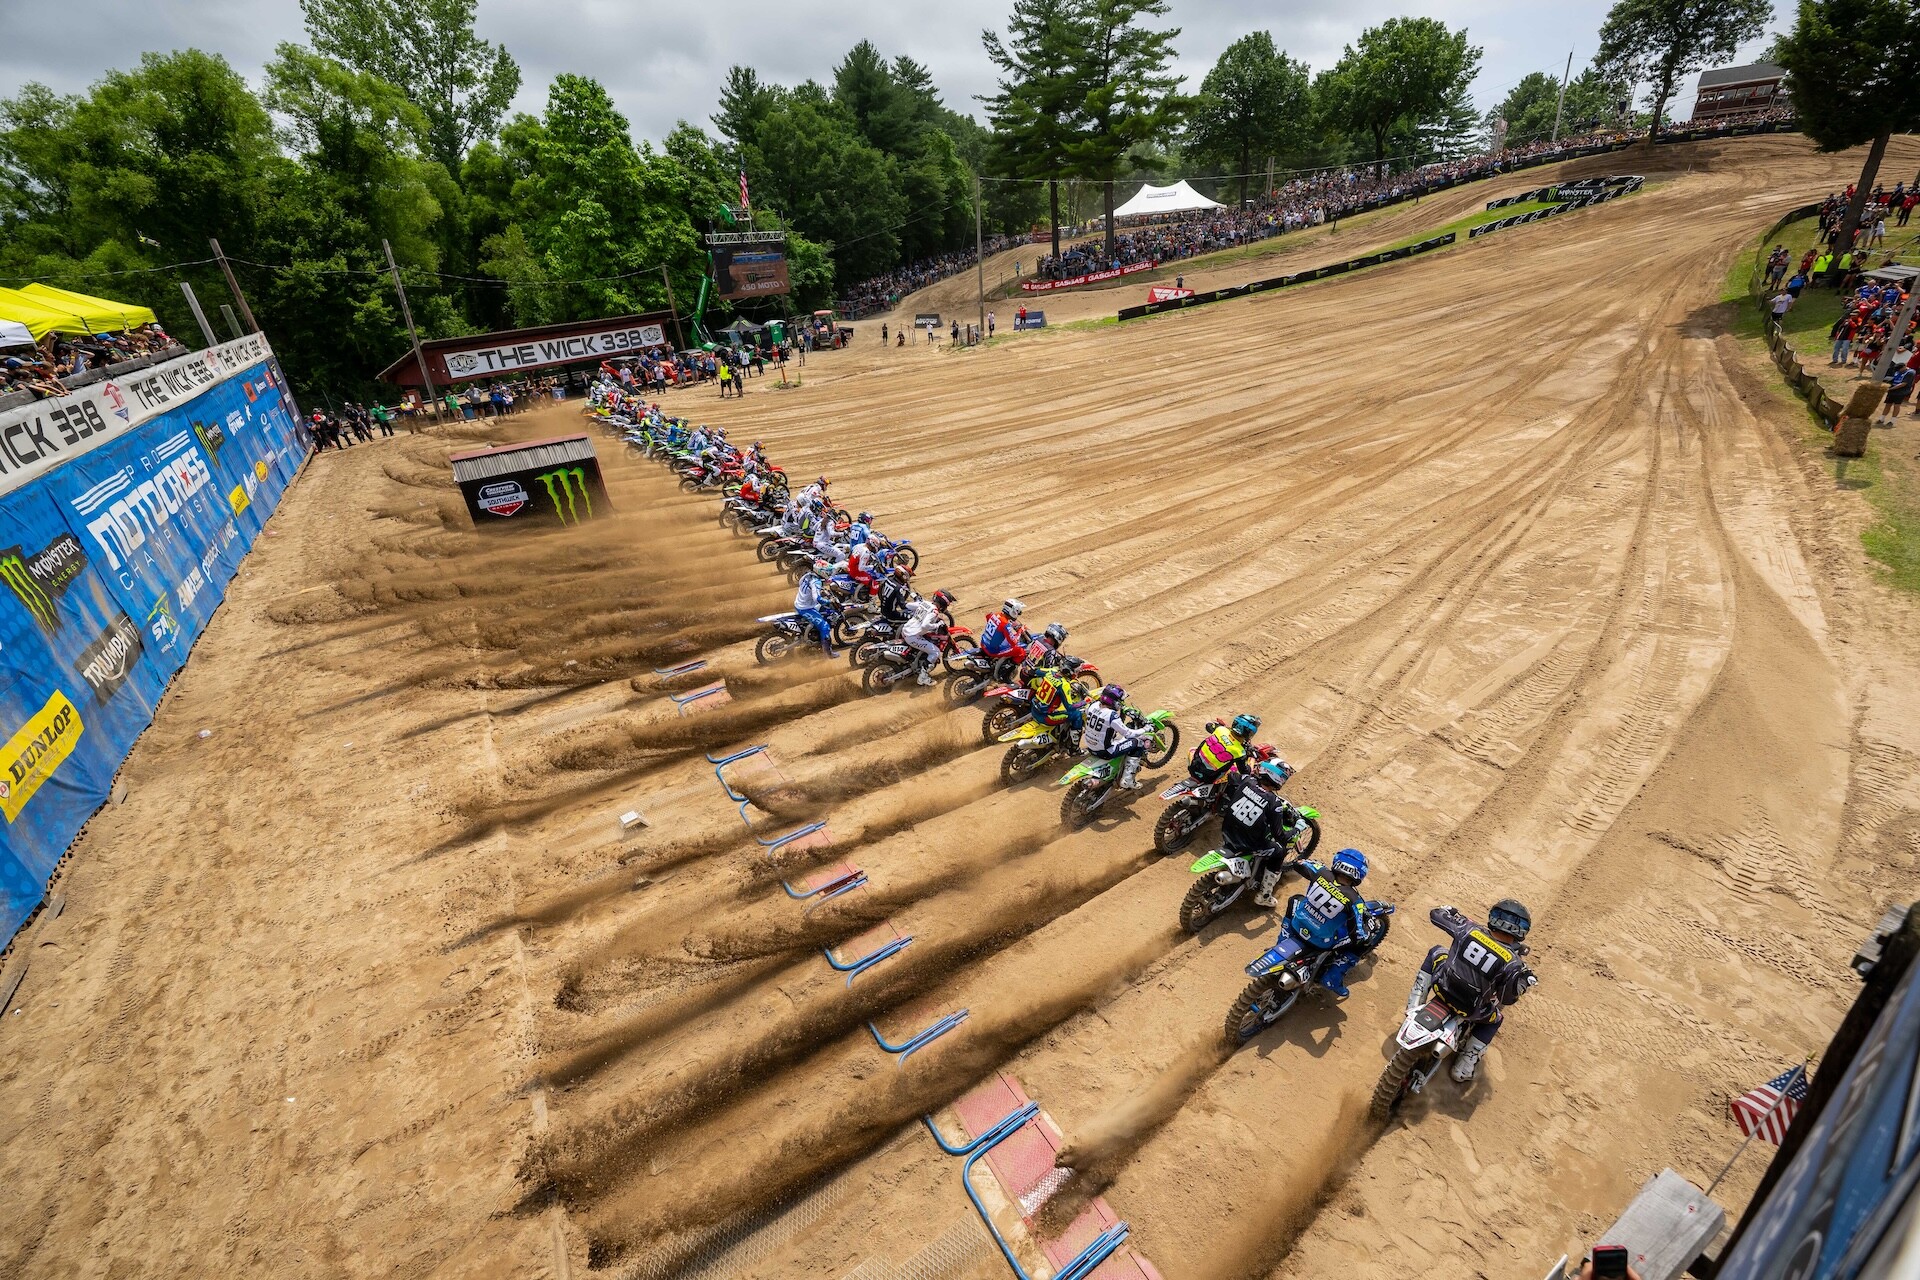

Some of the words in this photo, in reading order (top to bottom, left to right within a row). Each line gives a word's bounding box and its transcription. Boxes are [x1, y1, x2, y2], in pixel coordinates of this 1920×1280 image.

[741, 283, 756, 291] 450
[758, 281, 780, 289] MOTO
[1054, 277, 1085, 287] GASGAS
[1088, 270, 1120, 281] GASGAS
[478, 345, 538, 369] THE
[539, 336, 598, 360] WICK
[600, 330, 643, 351] 338
[130, 378, 170, 410] THE
[161, 365, 198, 397] WICK
[188, 359, 215, 384] 338
[0, 417, 59, 474] ICK
[49, 400, 106, 445] 338
[125, 449, 160, 481] PRO
[86, 446, 211, 571] MOTOCROSS
[487, 494, 519, 506] SOUTHWICK
[119, 482, 218, 591] CHAMPIONSHIP
[29, 537, 80, 579] MONSTER
[52, 560, 81, 587] ENERGY
[83, 630, 132, 688] TRIUMPH
[1087, 712, 1105, 732] 206
[8, 704, 71, 785] DUNLOP
[1037, 734, 1050, 744] 281
[1231, 796, 1263, 827] 489
[1306, 881, 1345, 919] 103
[1317, 876, 1350, 905] VERHAEGHE
[1304, 902, 1326, 924] YAMAHA
[1463, 941, 1498, 974] 81
[1471, 931, 1511, 961] JORGENSEN
